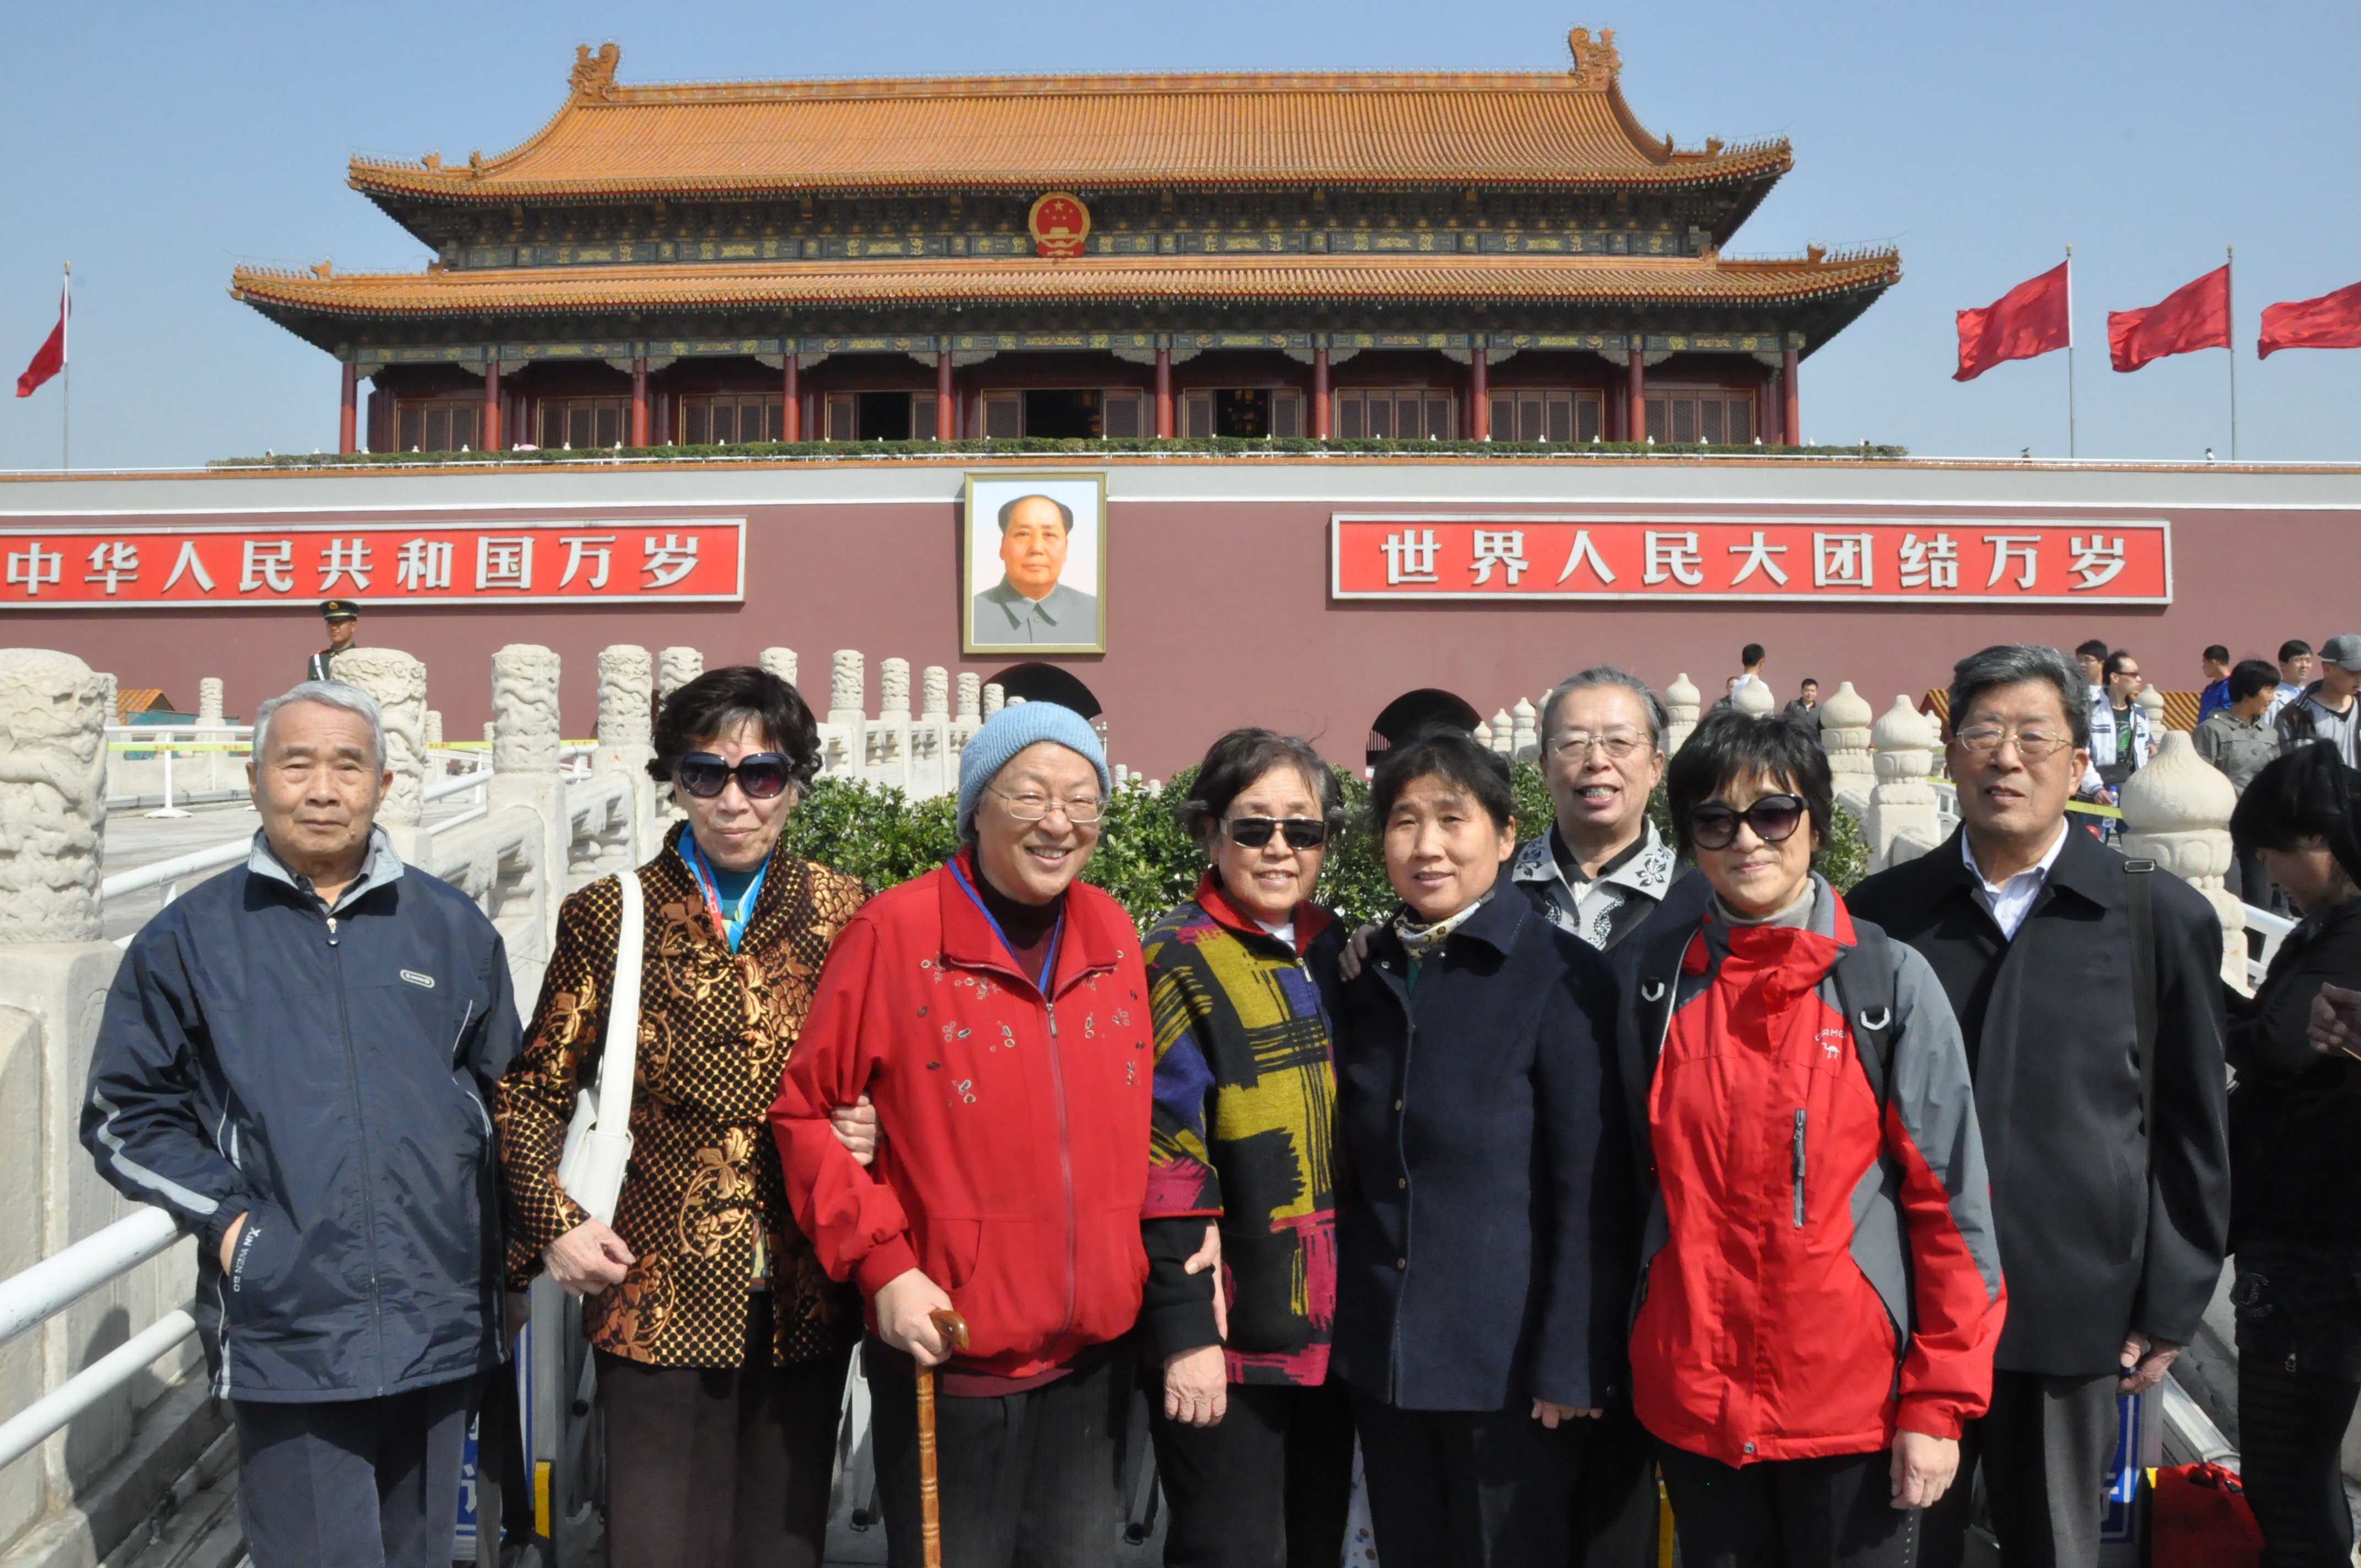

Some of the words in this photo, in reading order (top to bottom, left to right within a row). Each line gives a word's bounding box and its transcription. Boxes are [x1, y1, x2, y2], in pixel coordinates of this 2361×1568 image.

[7, 534, 699, 594] 中华人民共和国万岁
[1380, 529, 2128, 589] 世界人民大团结万岁
[243, 1227, 262, 1246] XIN
[235, 1248, 249, 1273] WEN
